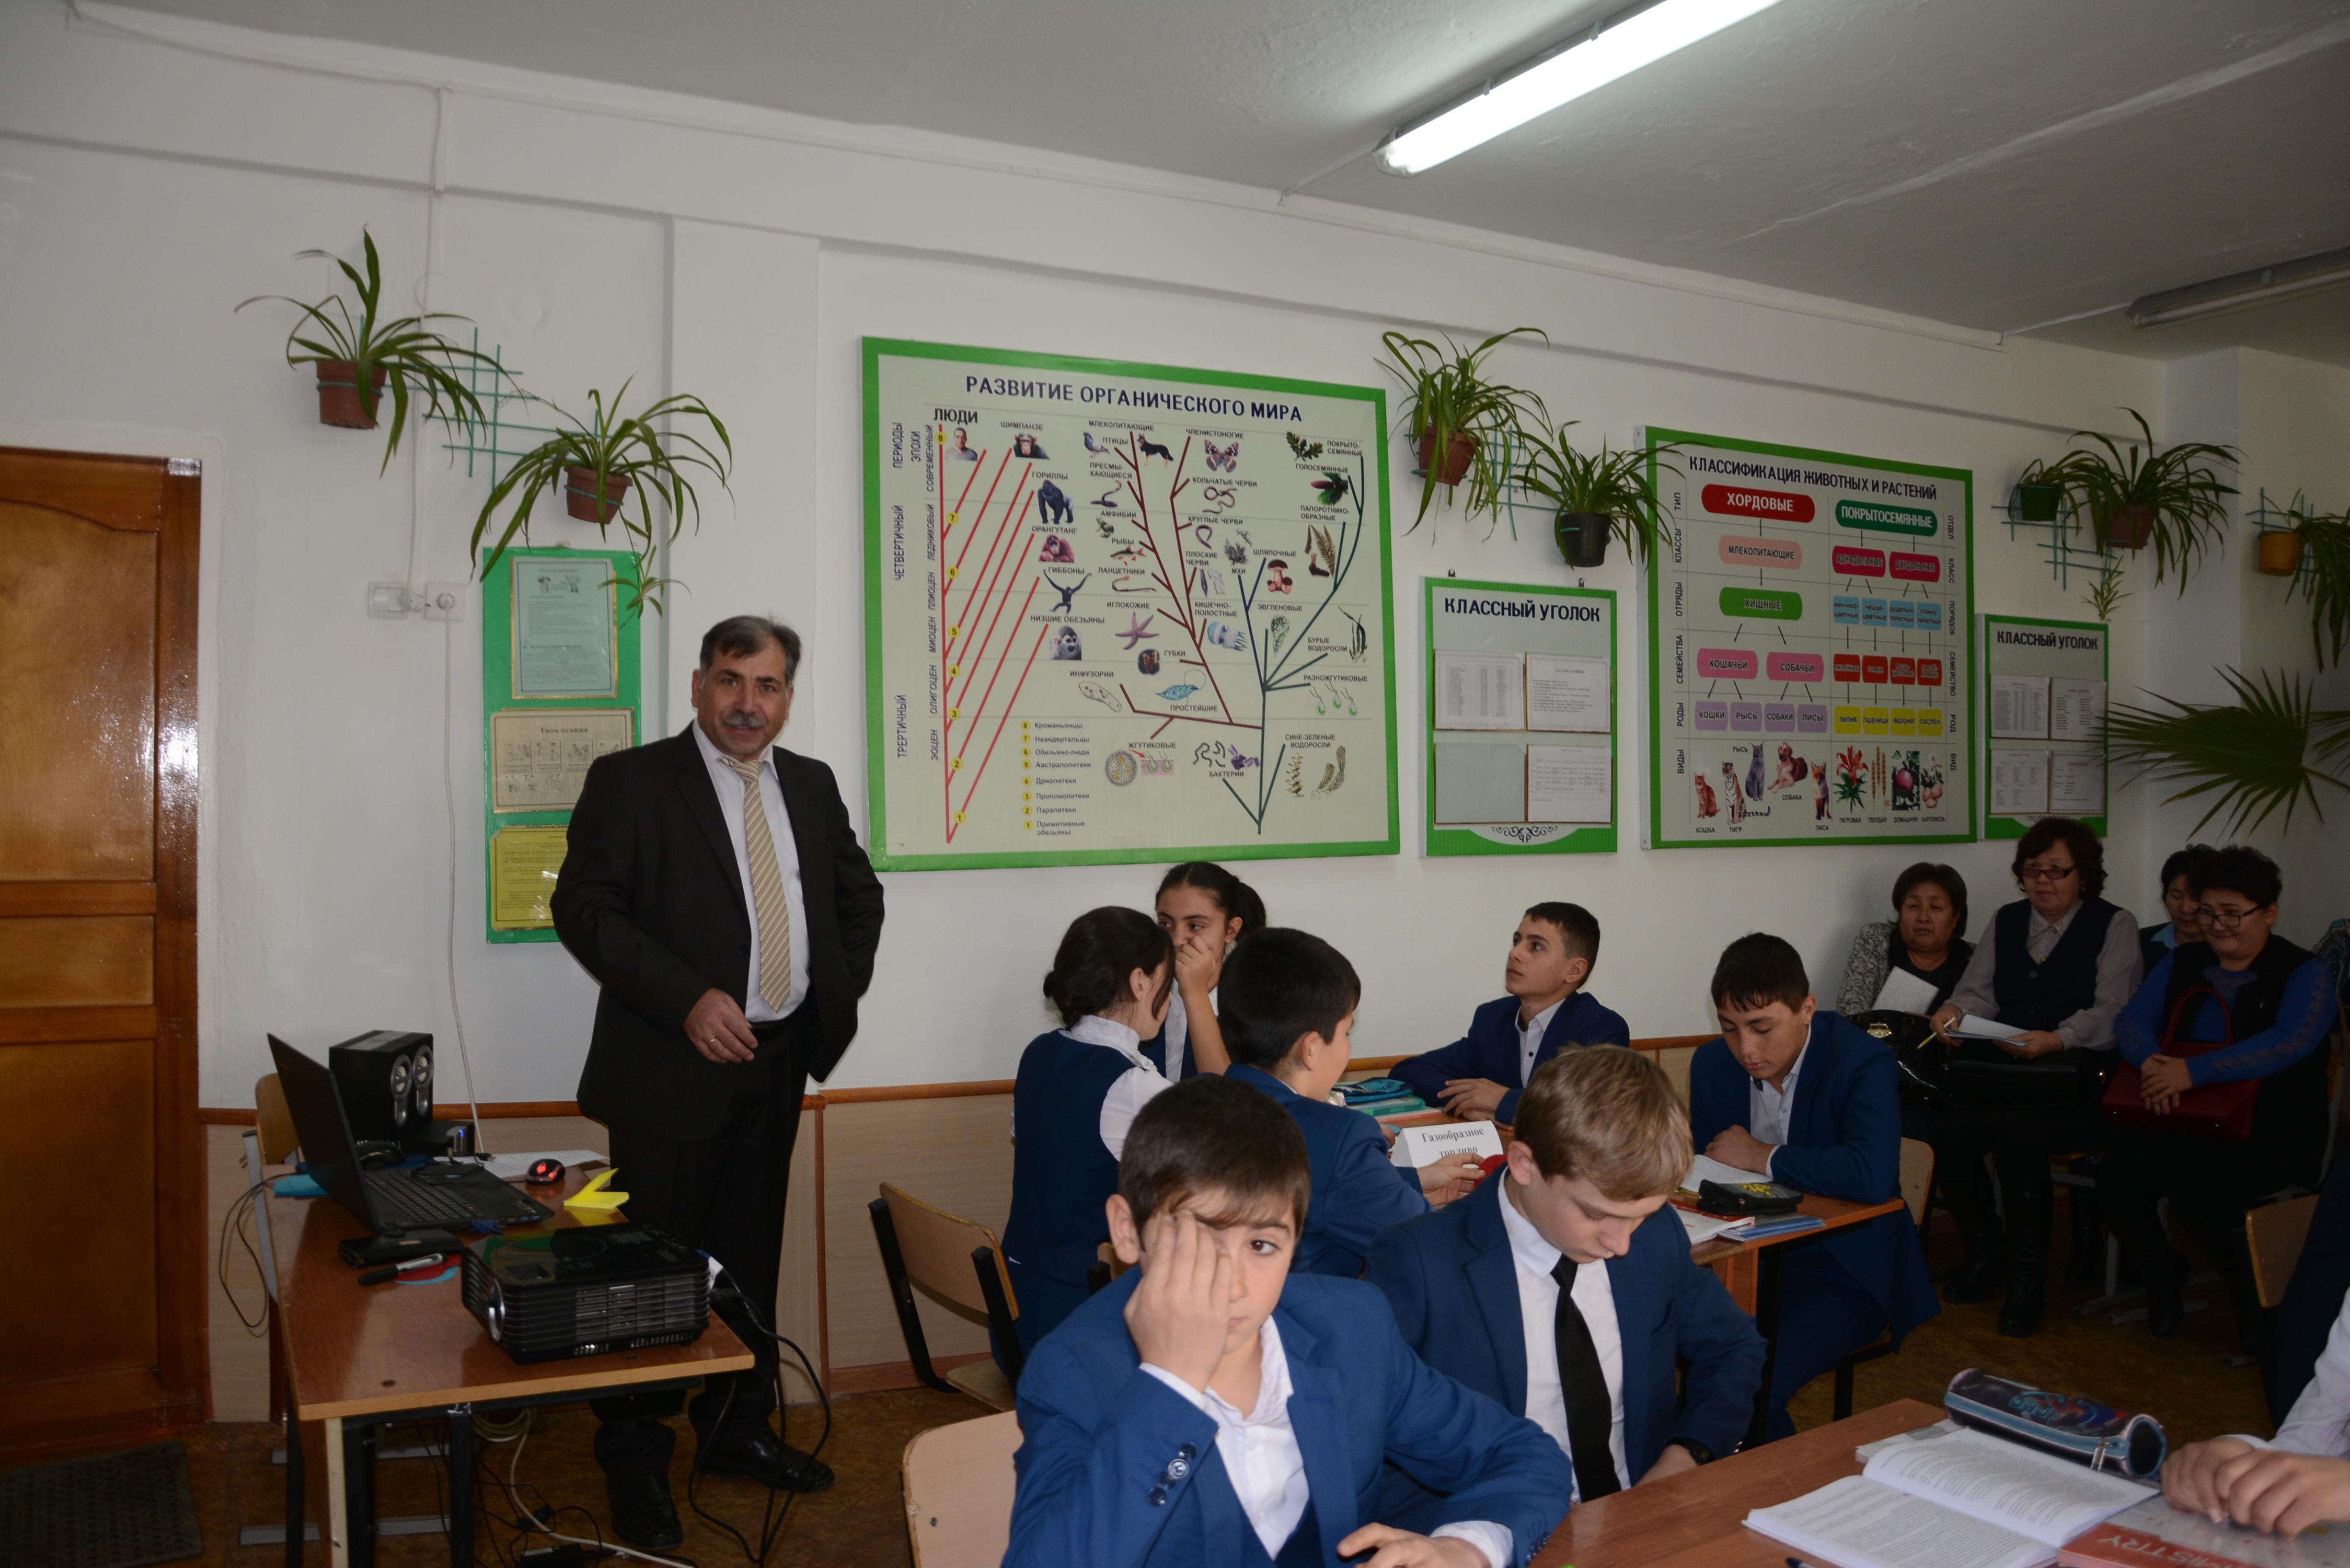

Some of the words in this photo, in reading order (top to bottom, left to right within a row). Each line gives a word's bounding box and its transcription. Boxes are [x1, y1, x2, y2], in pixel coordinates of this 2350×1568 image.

[966, 376, 1073, 401] РАЗВИТИЕ
[1080, 386, 1245, 417] ОРГАНИЧЕСКОГО
[1251, 402, 1302, 422] МИРА
[934, 408, 978, 425] ЛЮДИ
[1000, 421, 1043, 430] ШИМПАНЗЕ
[1089, 420, 1154, 431] МЛЕКОПИТАЮЩИЕ
[1186, 429, 1244, 439] ЧЛЕНИСТОНОГИЕ
[893, 422, 903, 468] ПЕРИОДЫ
[911, 431, 921, 463] ЭПОХИ
[925, 424, 934, 491] СОВРЕМЕННЫЙ
[1296, 464, 1349, 473] ГОЛОСЕМЯННЫЕ
[1032, 471, 1068, 480] ГОРИЛЛЫ
[1090, 470, 1133, 479] КАЮЩИЕСЯ
[1689, 456, 1801, 483] КЛАССИФИКАЦИЯ
[1804, 470, 1869, 492] ЖИВОТНЫХ
[1872, 480, 1879, 493] И
[1882, 481, 1937, 500] РАСТЕНИЙ
[1727, 492, 1793, 512] ХОРДОВЫЕ
[1300, 505, 1350, 514] ПАПОРОТНИКО-
[1300, 513, 1335, 521] ОБРАЗНЫЕ
[1841, 506, 1932, 528] ПОКРЫТОСЕМЯННЫЕ
[926, 503, 935, 561] ЛЕДНИКОВЫЙ
[1031, 525, 1078, 534] ОРАНГУТАНГ
[893, 505, 903, 580] ЧЕТВЕРТИЧНЫЙ
[1253, 549, 1296, 557] ШЛЯПОЧНЫЕ
[1728, 546, 1794, 560] МЛЕКОПИТАЮЩИЕ
[1048, 566, 1085, 574] ГИББОНЫ
[1098, 566, 1145, 575] ЛАНЦЕТНИКИ
[927, 571, 936, 610] ПЛИОЦЕН
[1107, 601, 1150, 609] ИГЛОКОЖИЕ
[1194, 602, 1230, 610] КИШЕЧНО-
[1258, 603, 1303, 612] ЭВГЛЕНОВЫЕ
[1744, 598, 1782, 610] ХИЩНЫЕ
[1194, 609, 1237, 618] ПОЛОСТНЫЕ
[1445, 598, 1536, 618] КЛАССНЫЙ
[1540, 604, 1600, 622] УГОЛОК
[1030, 615, 1063, 623] НИЗШИЕ
[1064, 615, 1105, 624] ОБЕЗЬЯНЫ
[1997, 630, 2057, 648] КЛАССНЫЙ
[2059, 637, 2098, 650] УГОЛОК
[1307, 644, 1347, 653] ВОДОРОСЛИ
[1675, 635, 1683, 684] СЕМЕЙСТВА
[1710, 660, 1747, 670] КОШАЧЬИ
[1780, 663, 1815, 673] СОБАЧЬИ
[1304, 674, 1368, 683] РАЗНОЖГУТИКОВЫЕ
[1170, 703, 1217, 712] ПРОСТЕЙШИЕ
[1034, 721, 1082, 730] Кроманьонцы
[1863, 717, 1888, 725] ПШЕНИЦА
[894, 694, 907, 758] ТРЕРТИЧНЫЙ
[1034, 735, 1089, 744] Неандертальцы
[1035, 777, 1077, 786] Дриопитеки
[1037, 820, 1085, 828] Примитивные
[1037, 828, 1072, 837] обезьяны
[1421, 1127, 1485, 1143] Газообразное
